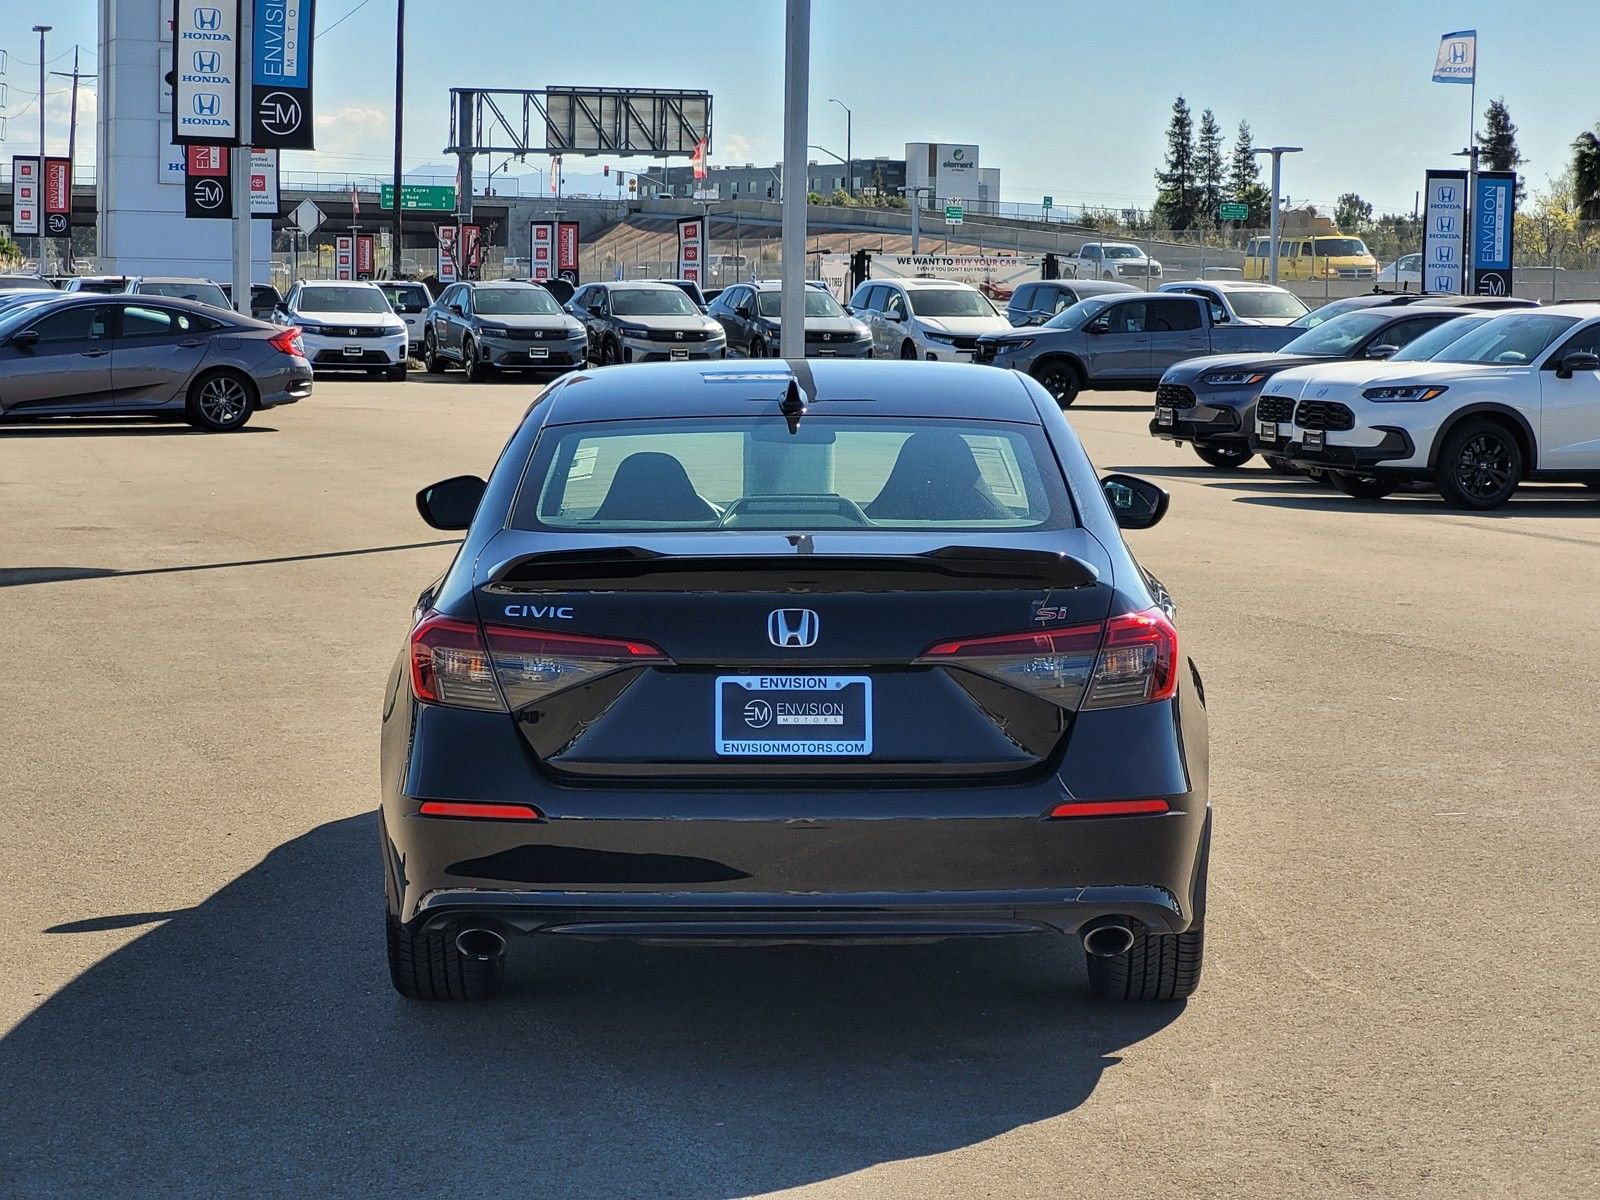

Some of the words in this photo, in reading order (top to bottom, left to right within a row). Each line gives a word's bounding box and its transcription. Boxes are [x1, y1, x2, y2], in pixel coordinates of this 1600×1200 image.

[182, 32, 232, 41] HONDA
[264, 0, 284, 76] ENVISI
[182, 75, 231, 84] HONDA
[182, 117, 231, 127] HONDA
[50, 164, 59, 209] ENVISION
[1482, 185, 1496, 262] ENVISION
[897, 257, 911, 265] WE
[942, 258, 953, 266] TO
[956, 258, 973, 266] BUY
[974, 258, 998, 267] YOUR
[1000, 259, 1017, 267] CAR
[504, 605, 574, 619] CIVIC
[1034, 606, 1068, 621] Si
[760, 677, 828, 689] ENVISION
[776, 702, 844, 715] ENVISION
[723, 743, 865, 753] ENVISIONMOTORS.COM
